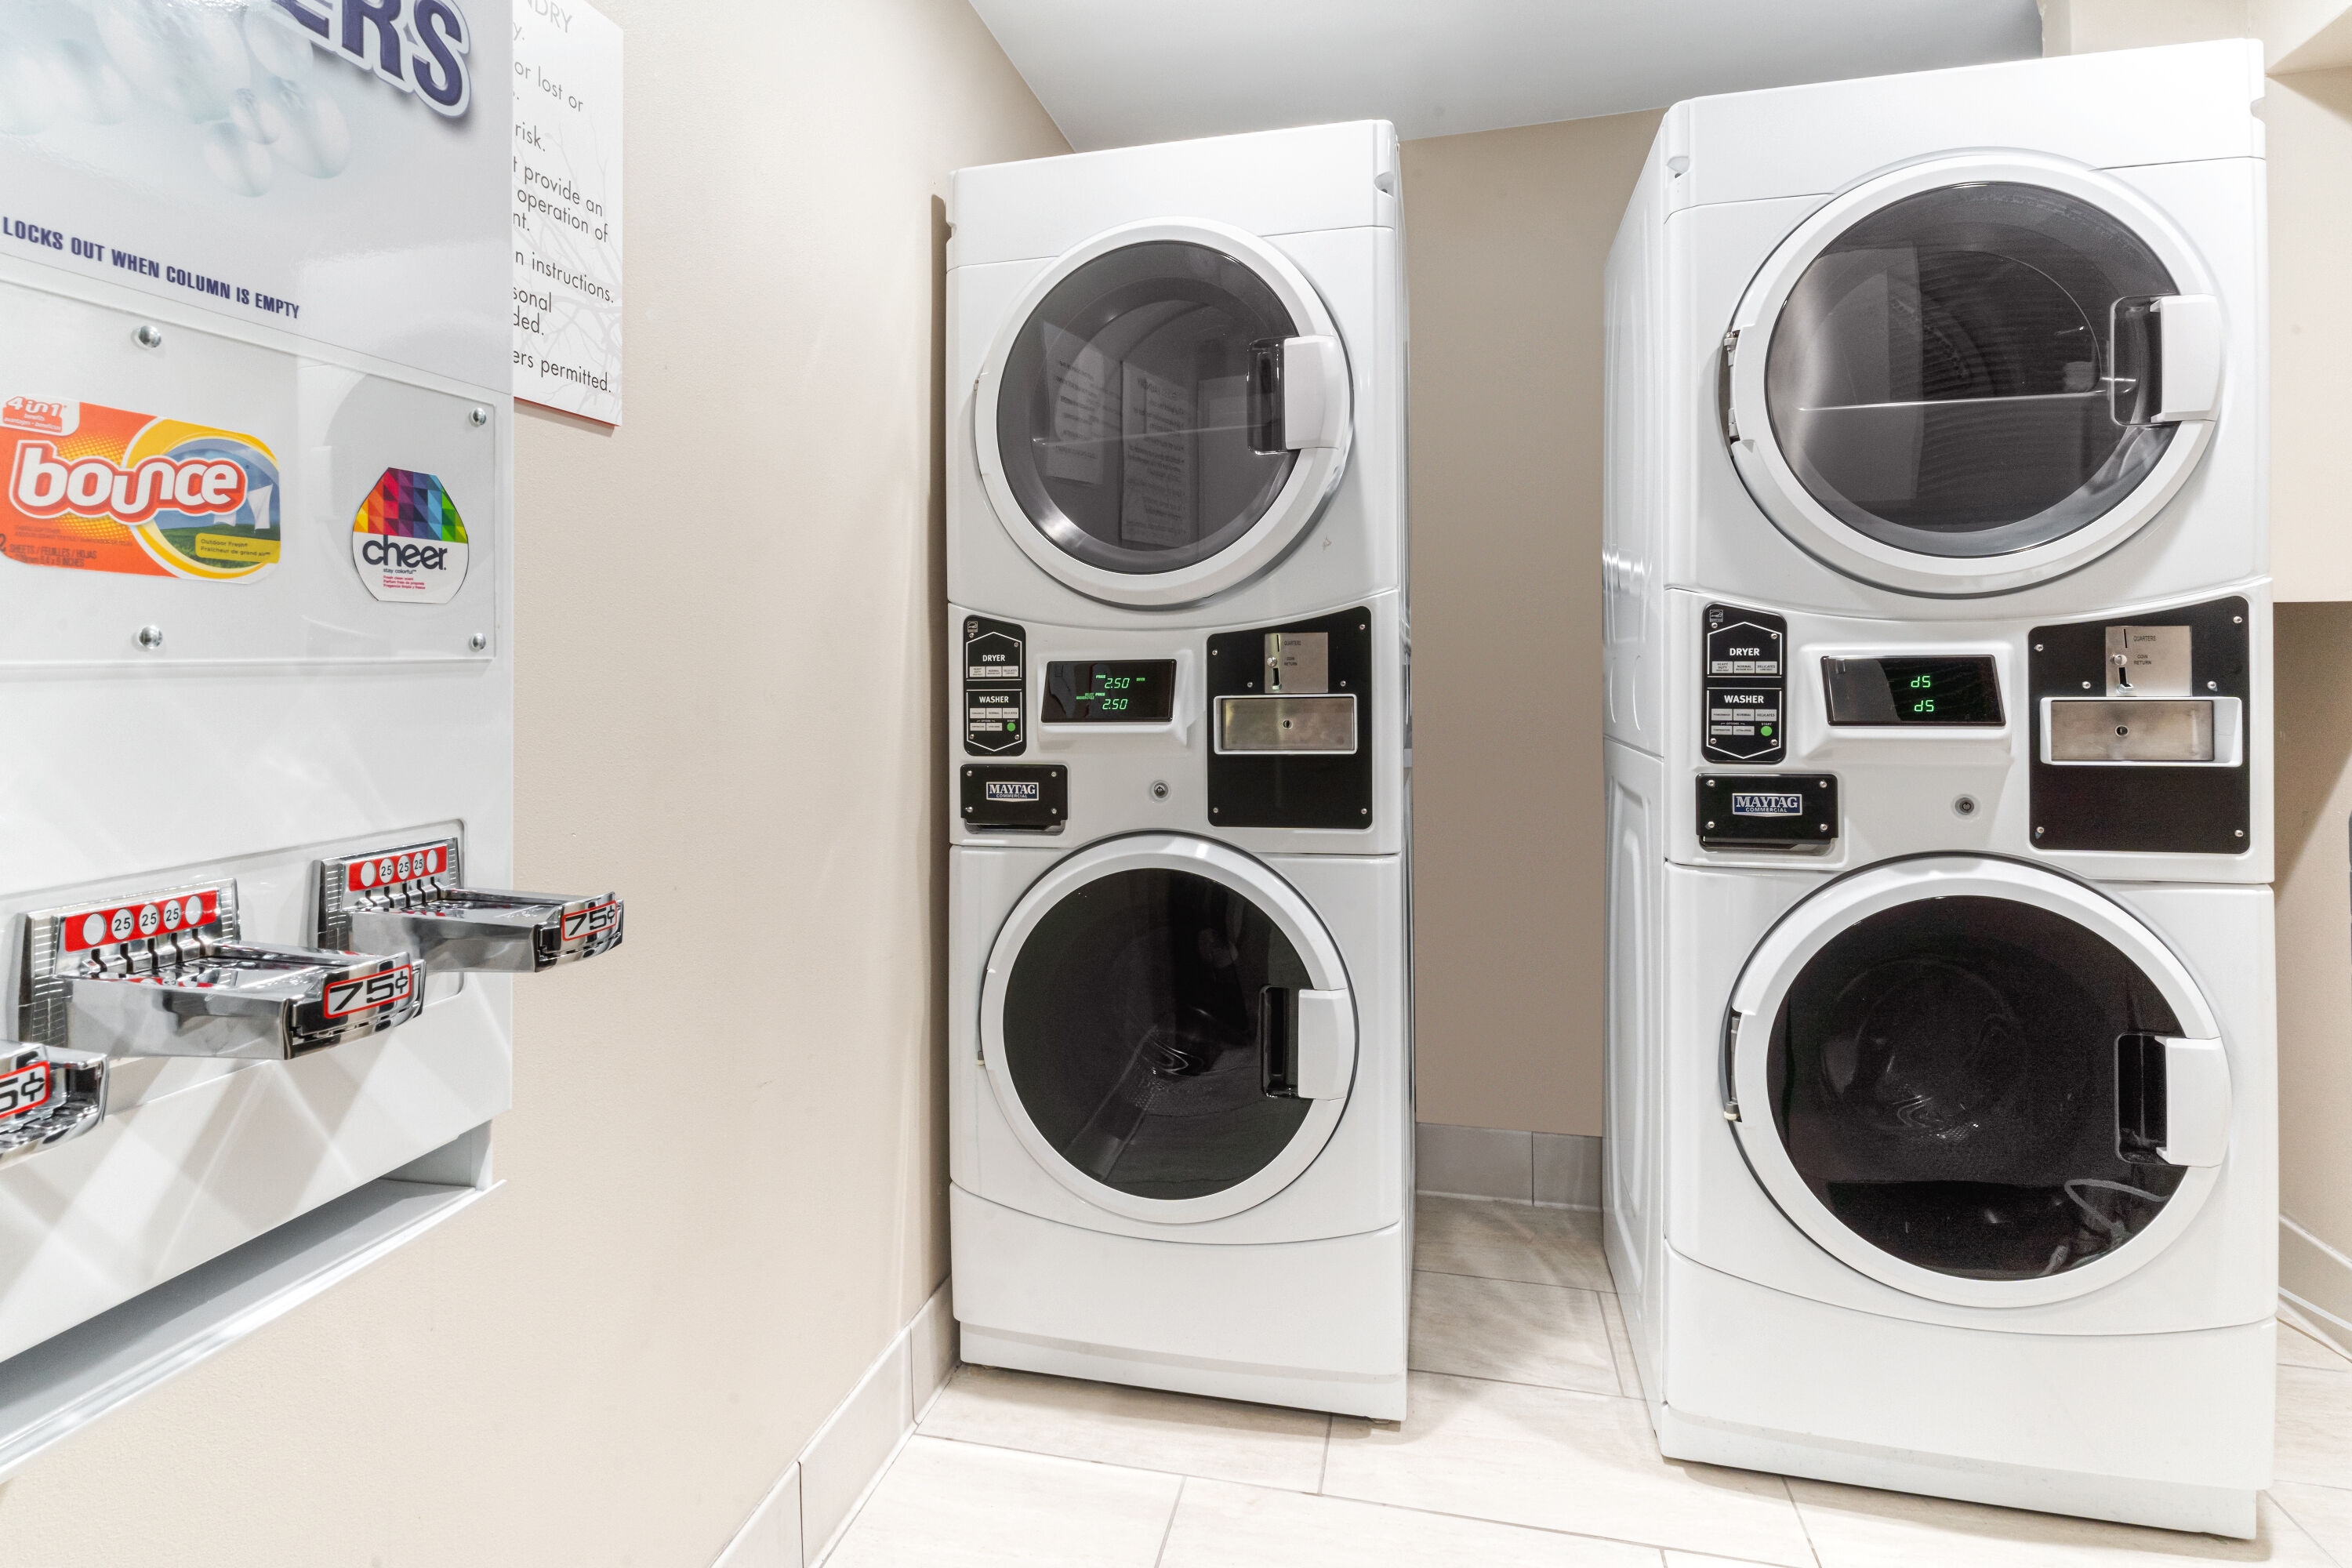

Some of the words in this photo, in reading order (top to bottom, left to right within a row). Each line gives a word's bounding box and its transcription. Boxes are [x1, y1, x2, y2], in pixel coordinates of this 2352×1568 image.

[538, 65, 563, 100] lost
[568, 96, 583, 112] or
[515, 122, 546, 152] risk.
[524, 166, 580, 205] provide
[586, 199, 603, 217] an
[517, 190, 588, 234] operation
[595, 223, 608, 243] of
[3, 216, 64, 250] LOCKS
[71, 237, 105, 262] OUT
[111, 249, 160, 279] WHEN
[167, 266, 230, 299] COLUMN
[236, 287, 250, 305] IS
[256, 293, 299, 319] EMPTY
[532, 252, 614, 303] instructions.
[541, 359, 612, 393] permitted.
[16, 445, 241, 517] bounce
[1104, 678, 1130, 688] 2.50
[1102, 699, 1128, 709] 2.50
[1724, 695, 1764, 703] WASHER
[989, 784, 1035, 794] MAYTAG
[1736, 796, 1798, 808] MAYTAG
[381, 865, 392, 876] 25
[399, 862, 409, 873] 25
[414, 859, 423, 869] 25
[114, 917, 131, 931] 25
[142, 913, 157, 926] 25
[166, 908, 179, 922] 25
[565, 906, 615, 936] 75¢
[329, 971, 408, 1012] 75¢
